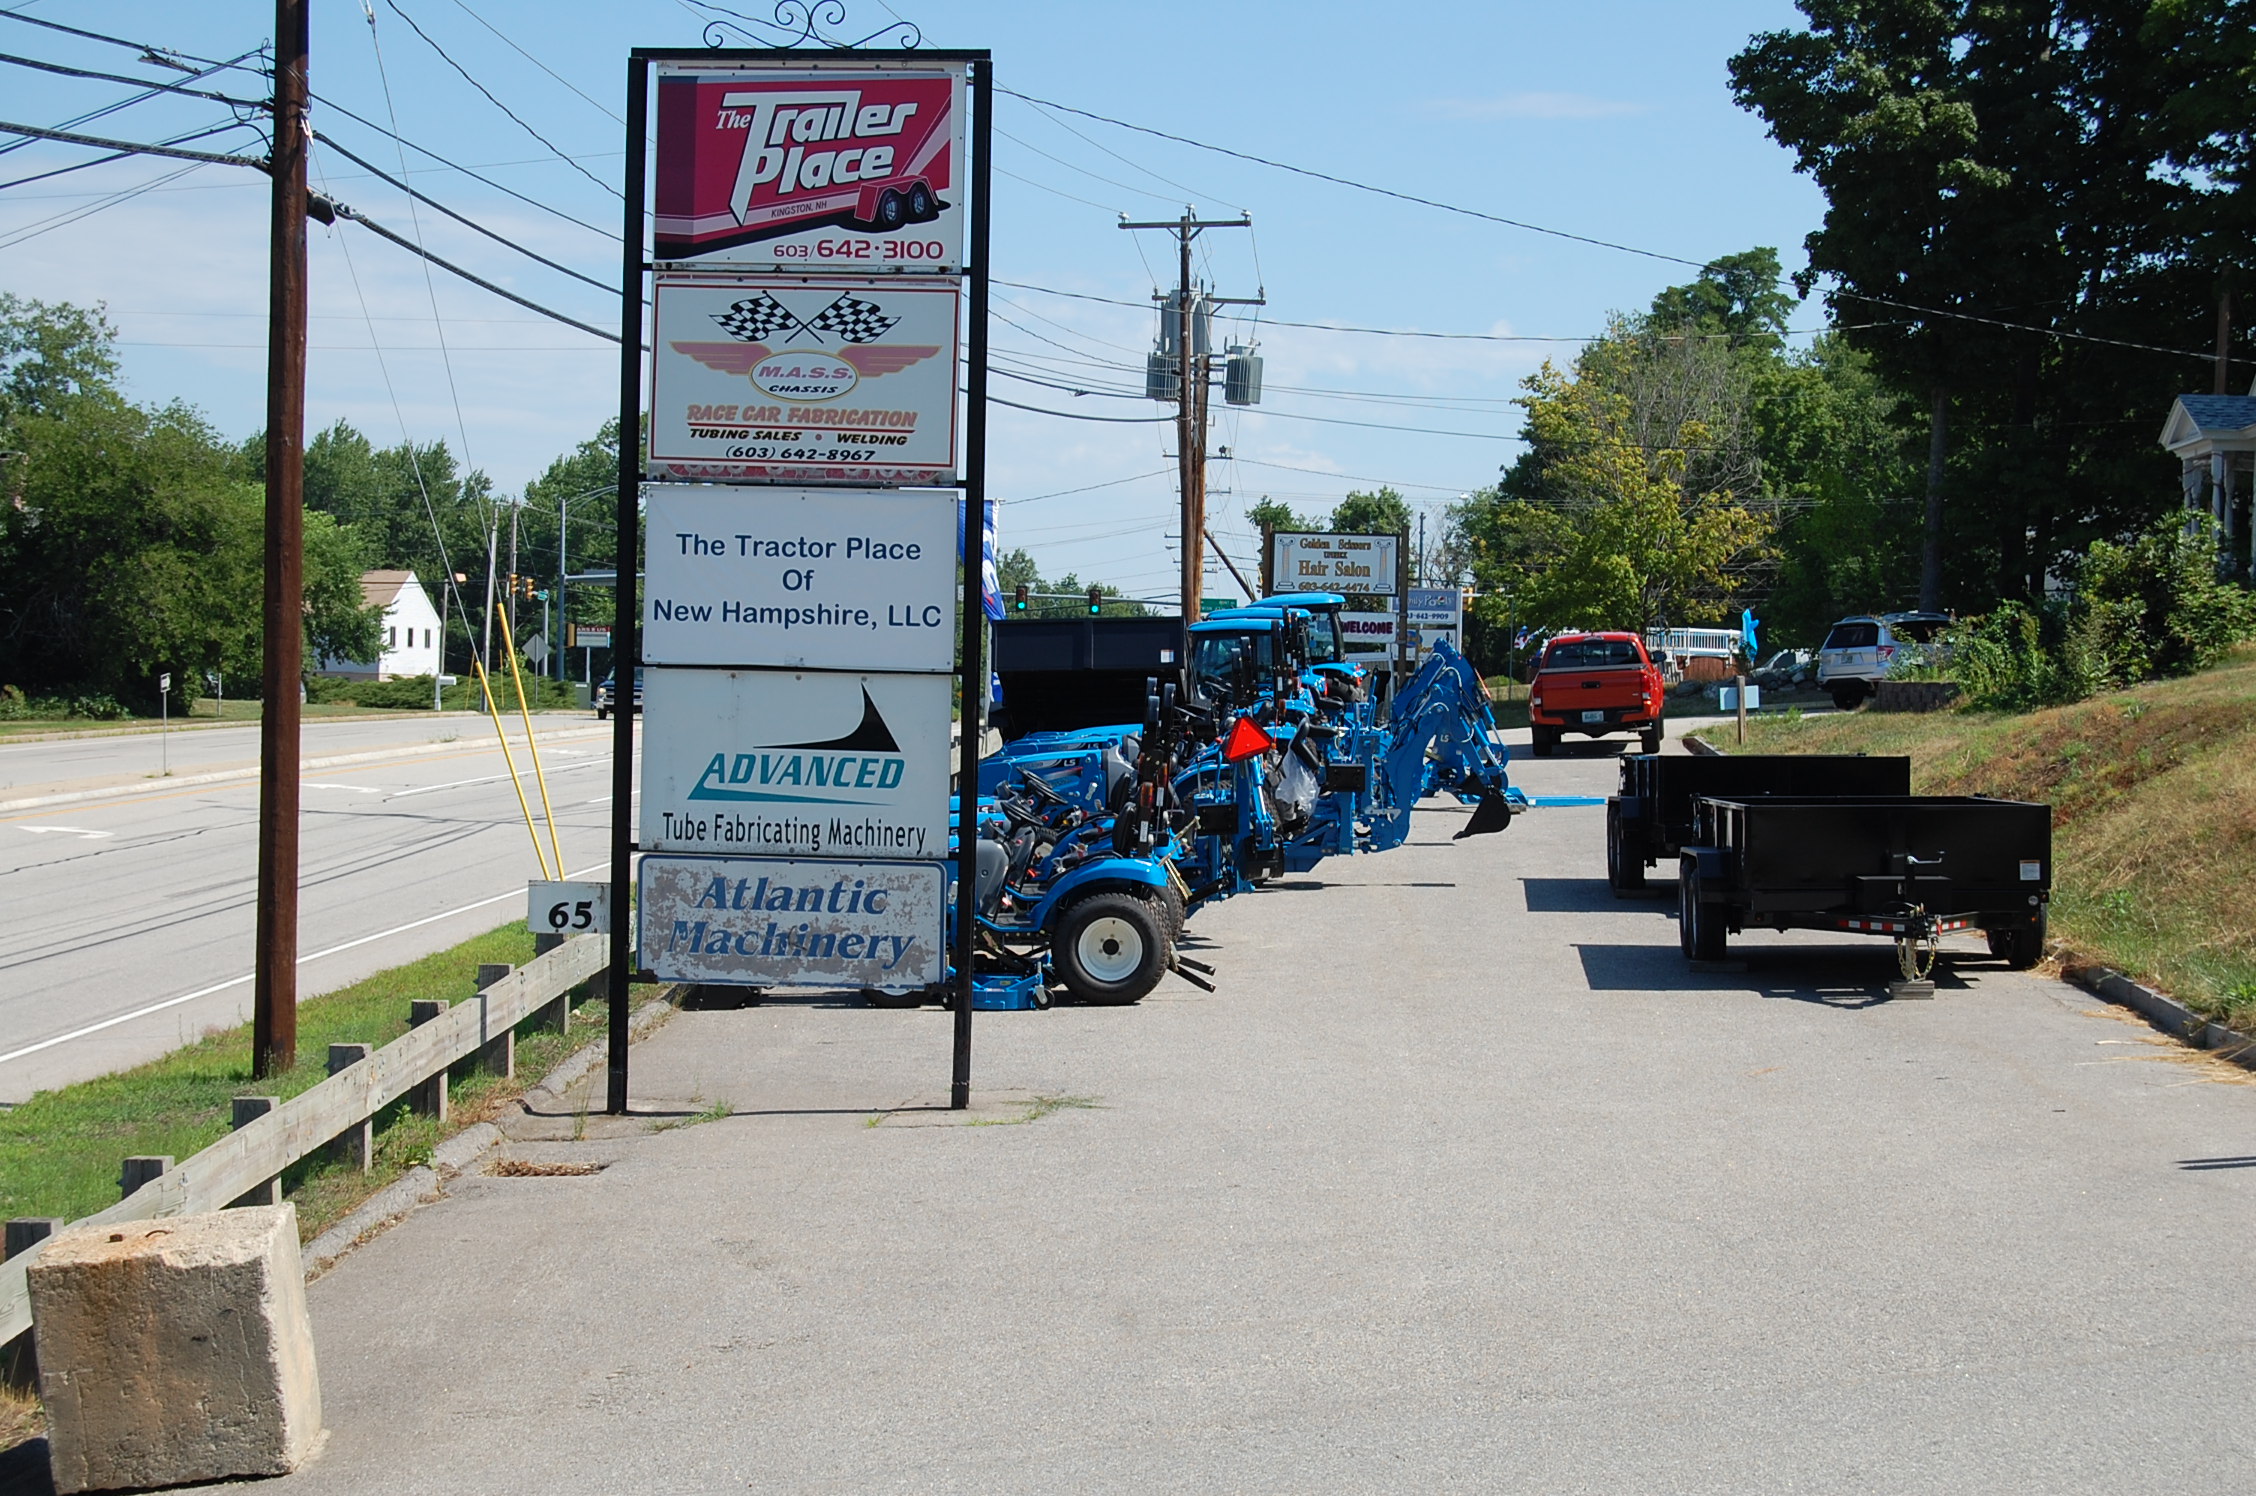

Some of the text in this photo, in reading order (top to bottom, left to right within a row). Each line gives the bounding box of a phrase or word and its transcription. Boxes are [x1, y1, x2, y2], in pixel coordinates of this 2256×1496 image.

[715, 90, 918, 149] The Trailer
[731, 145, 895, 214] Place
[771, 200, 828, 218] KINGSTON, NH
[758, 365, 853, 380] M.A.S.S.
[768, 384, 839, 395] CHASSIS
[687, 404, 918, 427] RACE CAR FABRICATION
[689, 428, 908, 446] TUBING SALES WELDING
[725, 445, 876, 462] (603) 642-8967
[676, 533, 922, 560] The Tractor Place
[1300, 538, 1330, 549] Golden
[1298, 560, 1371, 577] Hair Salon
[782, 569, 815, 592] Of
[653, 599, 942, 630] New Hampshire, LLC
[1407, 612, 1449, 620] 3-642-9909
[1341, 620, 1394, 635] WELCOME
[693, 753, 905, 790] ADVANCED
[1063, 758, 1076, 767] LS
[663, 812, 926, 855] Tube Fabricating Machinery
[696, 876, 889, 916] Atlantic
[548, 900, 593, 930] 65
[667, 920, 917, 970] Machinery
